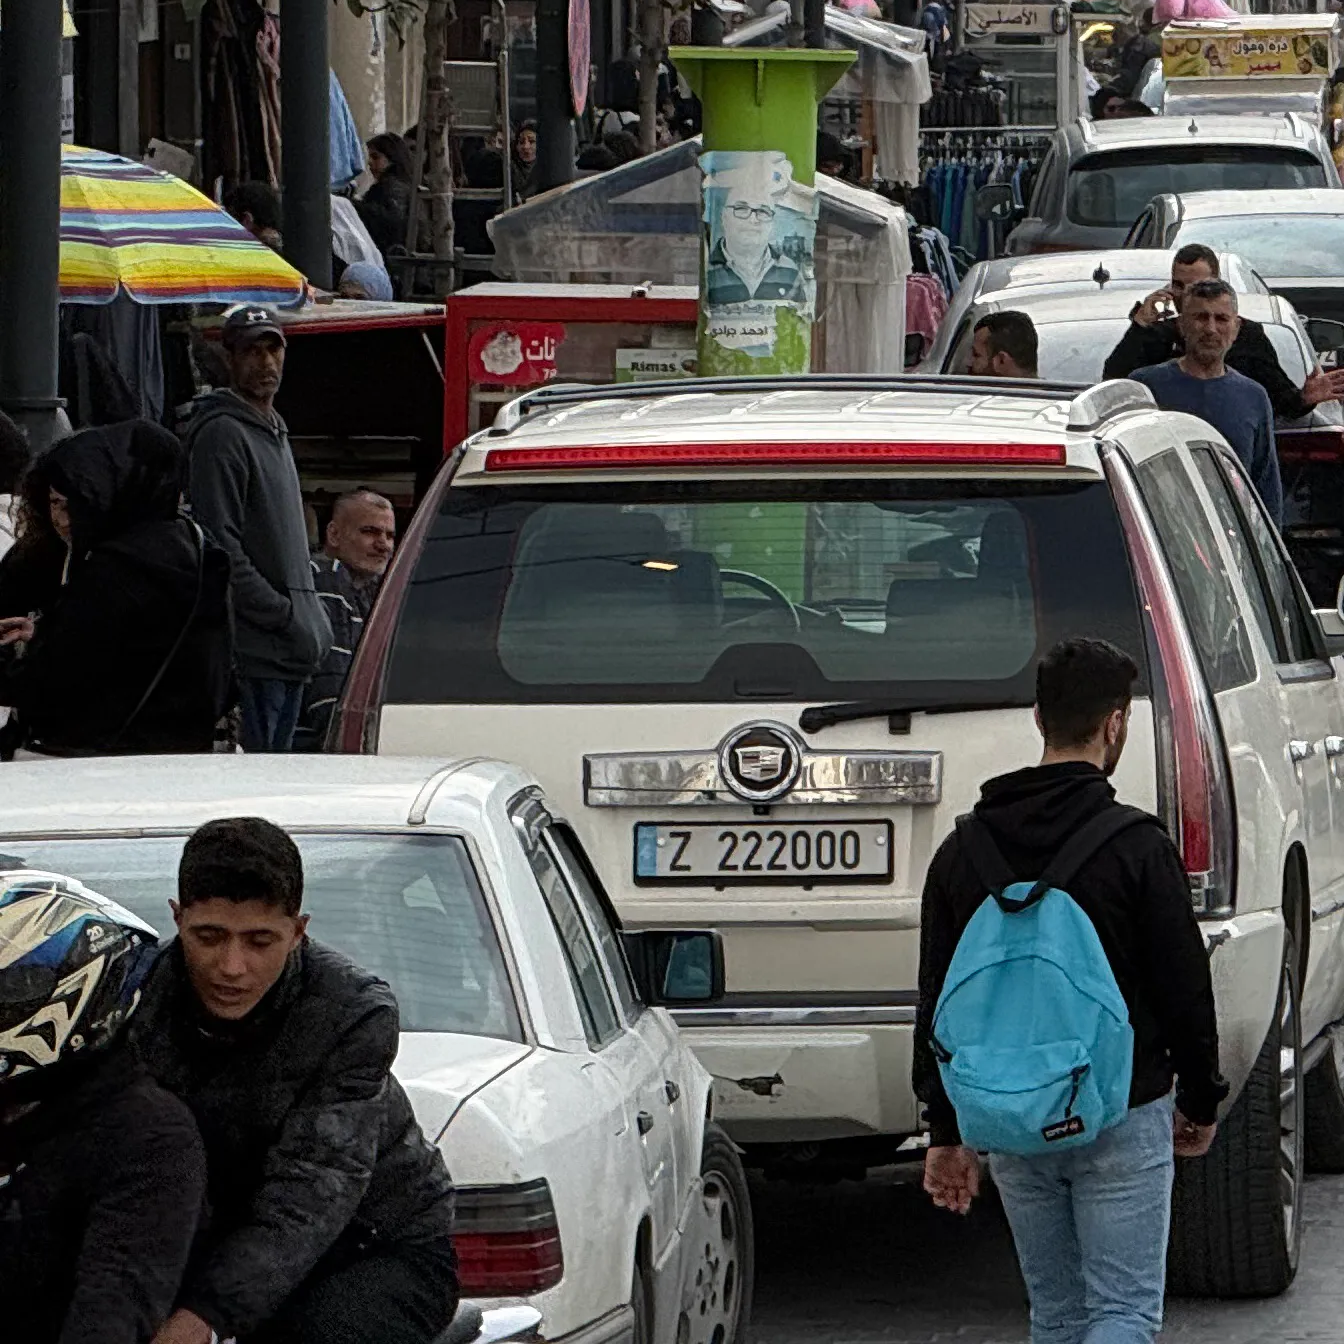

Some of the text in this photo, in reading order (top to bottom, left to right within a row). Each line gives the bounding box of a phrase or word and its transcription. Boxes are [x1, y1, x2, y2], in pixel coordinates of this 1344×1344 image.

[630, 361, 677, 373] Rimas
[669, 829, 861, 872] Z 222000
